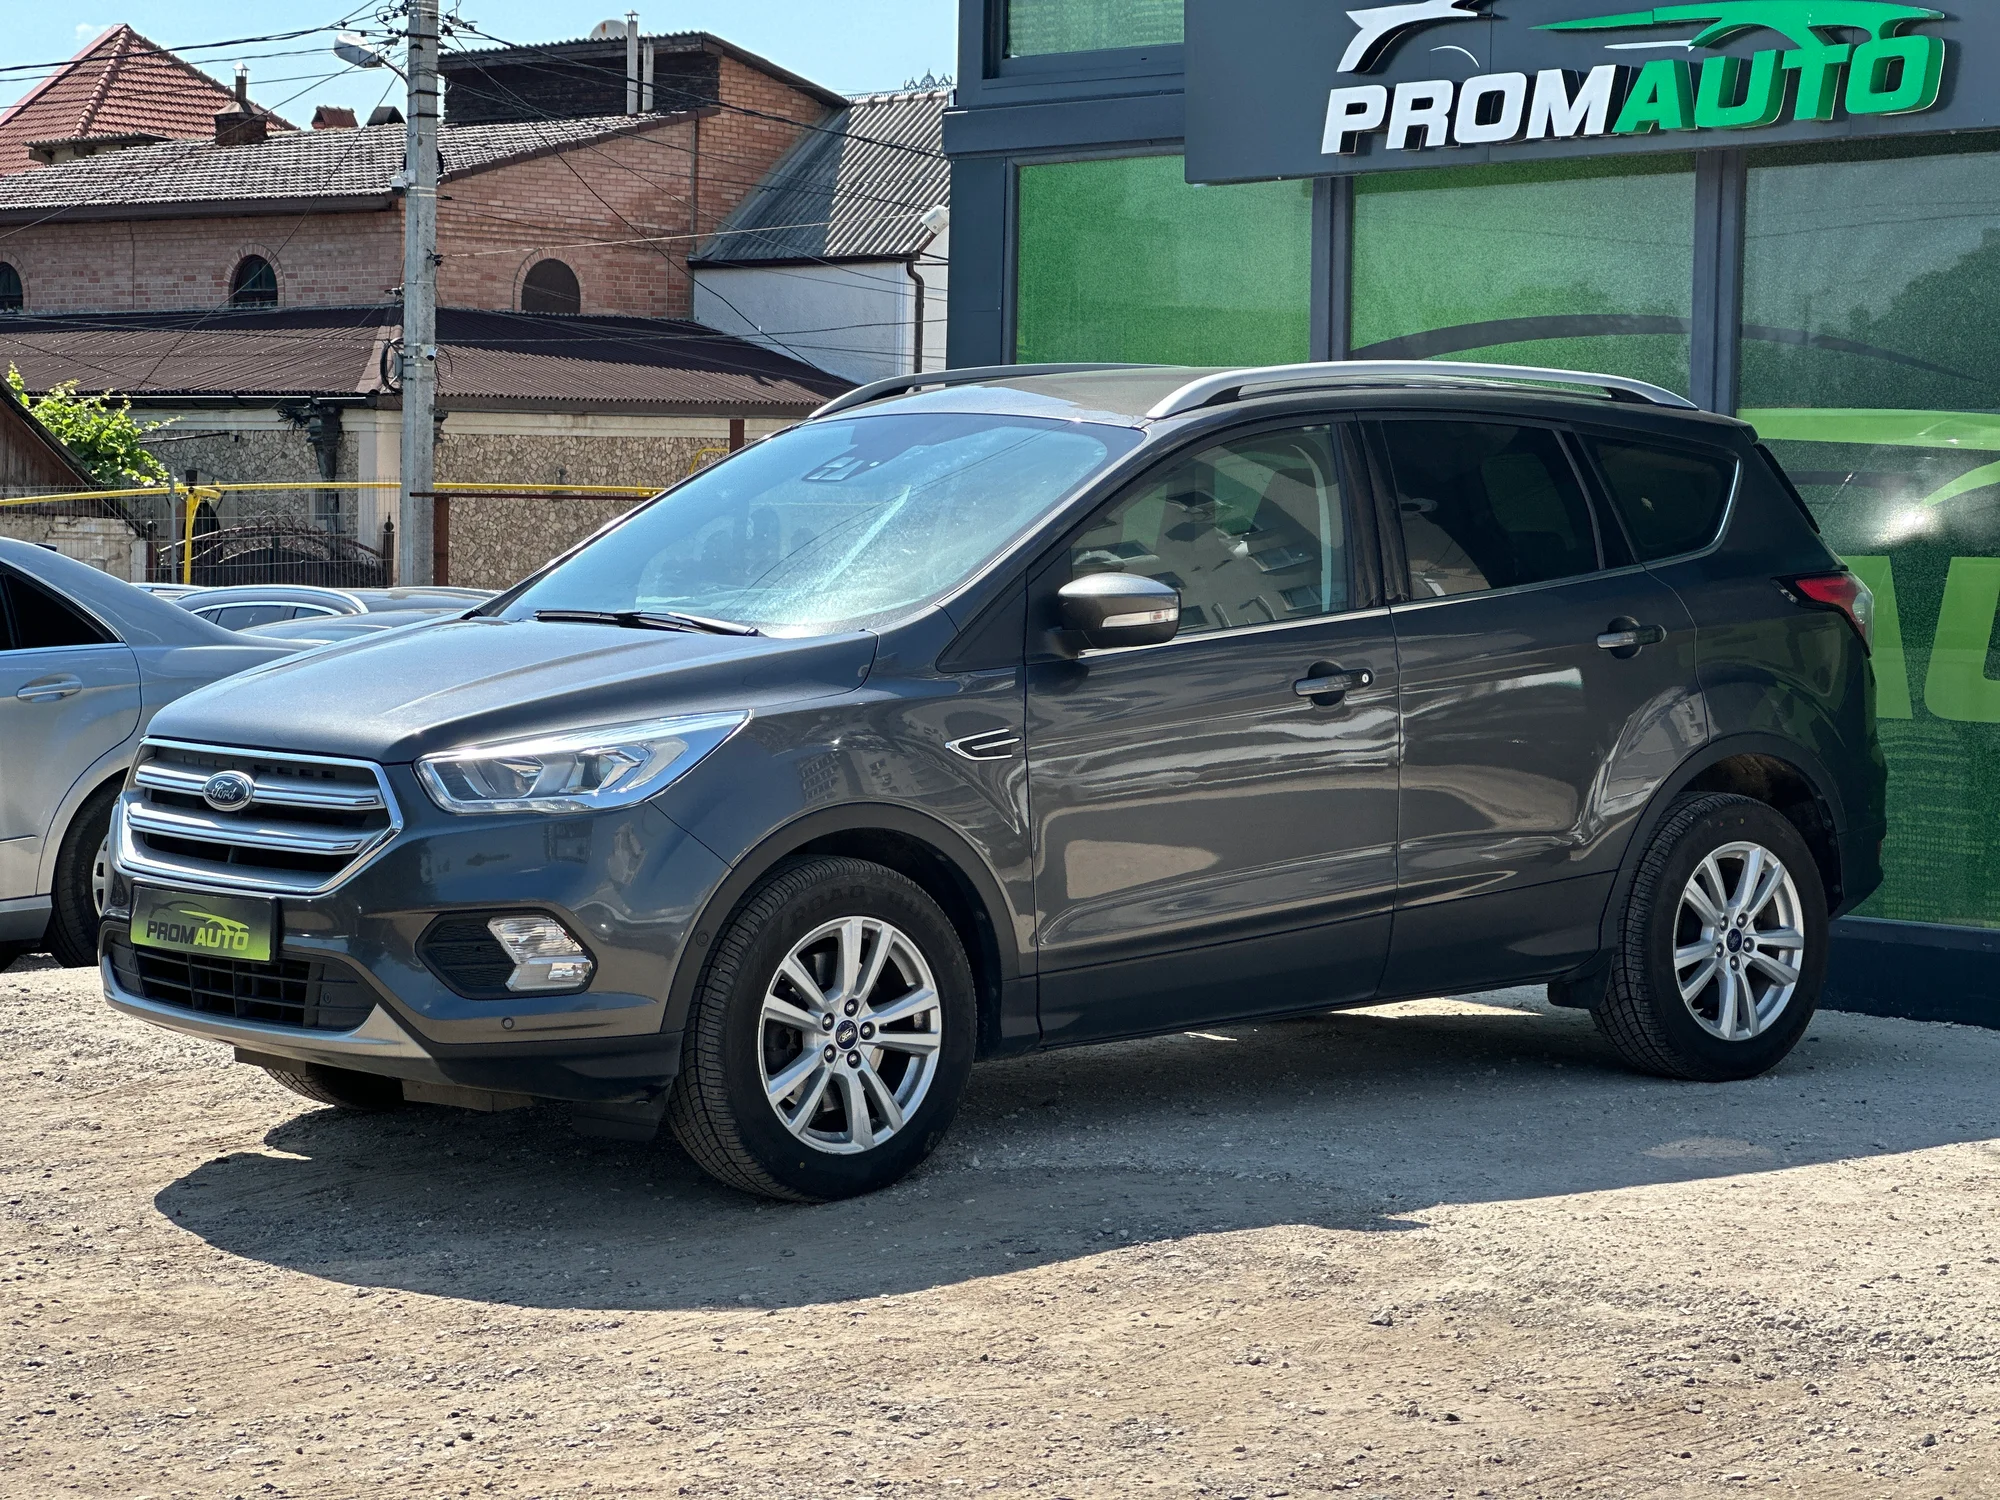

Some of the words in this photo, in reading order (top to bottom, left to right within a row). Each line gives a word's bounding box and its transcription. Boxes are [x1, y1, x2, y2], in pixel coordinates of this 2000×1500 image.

[1321, 34, 1942, 155] PROMAUTO
[207, 780, 237, 800] Ford
[146, 920, 250, 951] PROMAUTO
